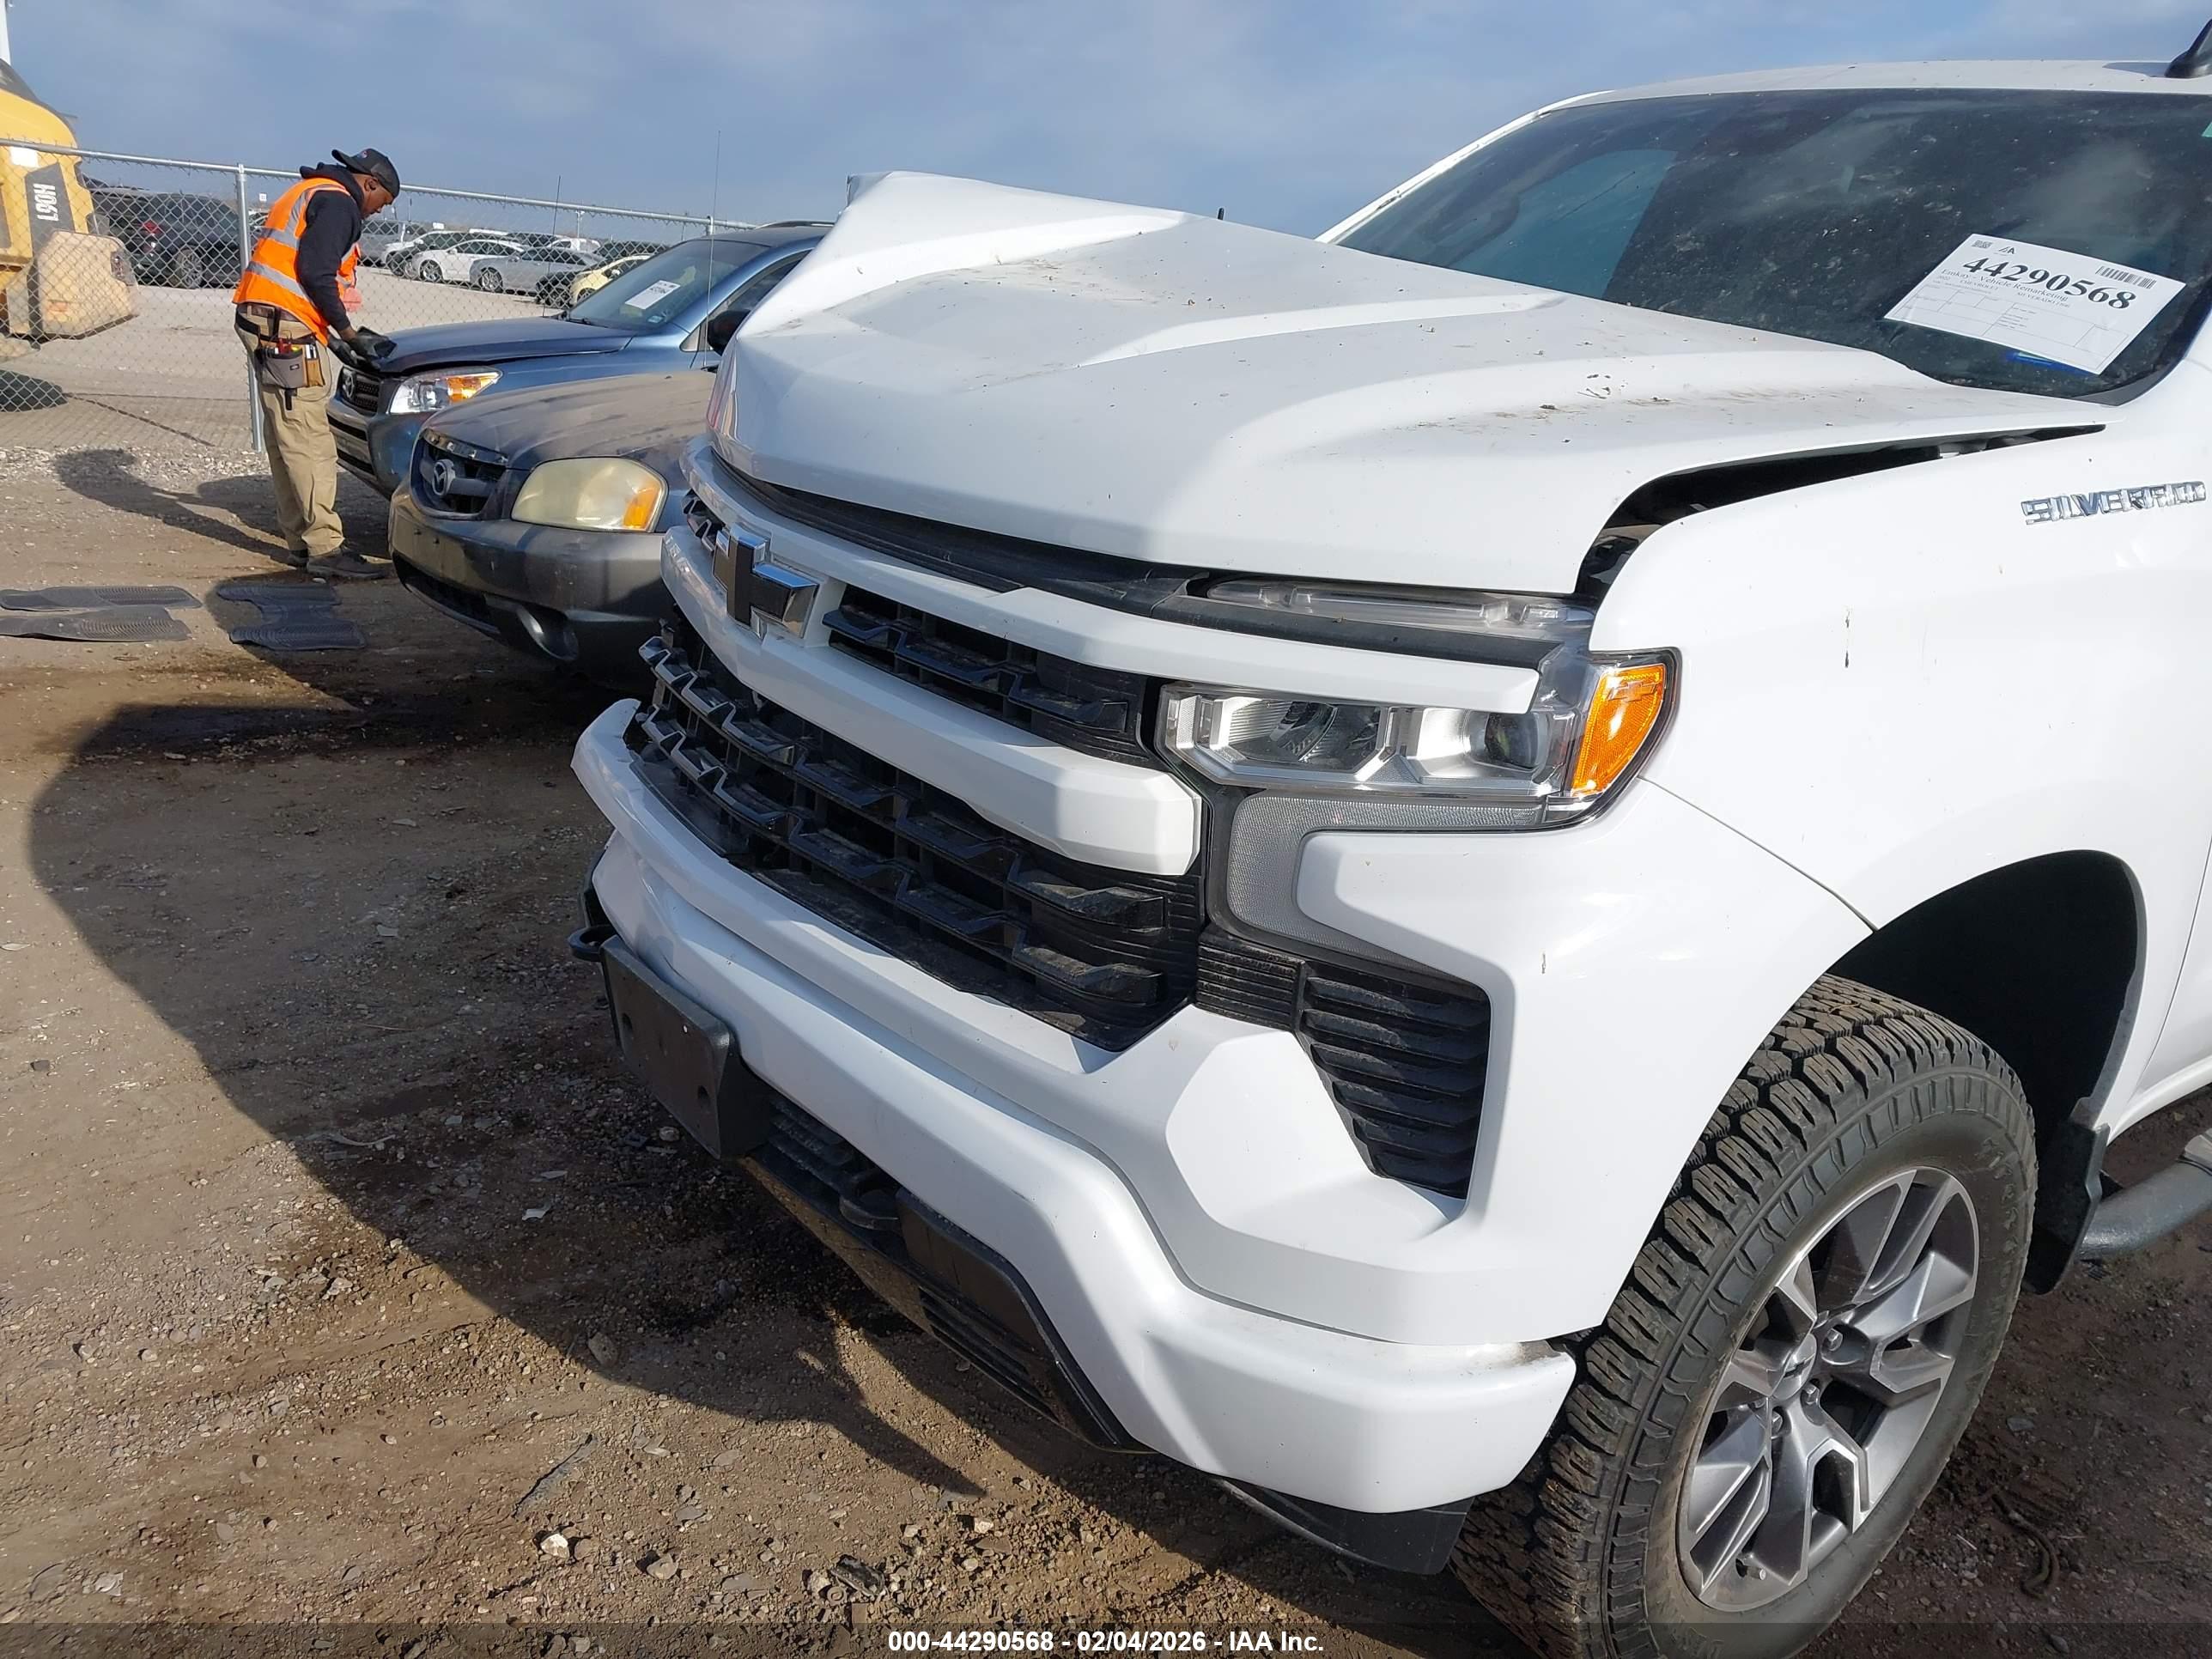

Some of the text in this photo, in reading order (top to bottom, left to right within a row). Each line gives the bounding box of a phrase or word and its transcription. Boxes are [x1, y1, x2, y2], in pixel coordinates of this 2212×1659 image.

[33, 183, 59, 222] L90H
[1963, 258, 2137, 310] 44290568
[1980, 276, 2011, 287] Vehicle
[2013, 283, 2069, 301] Remarketing
[2021, 481, 2207, 525] SILVERADO
